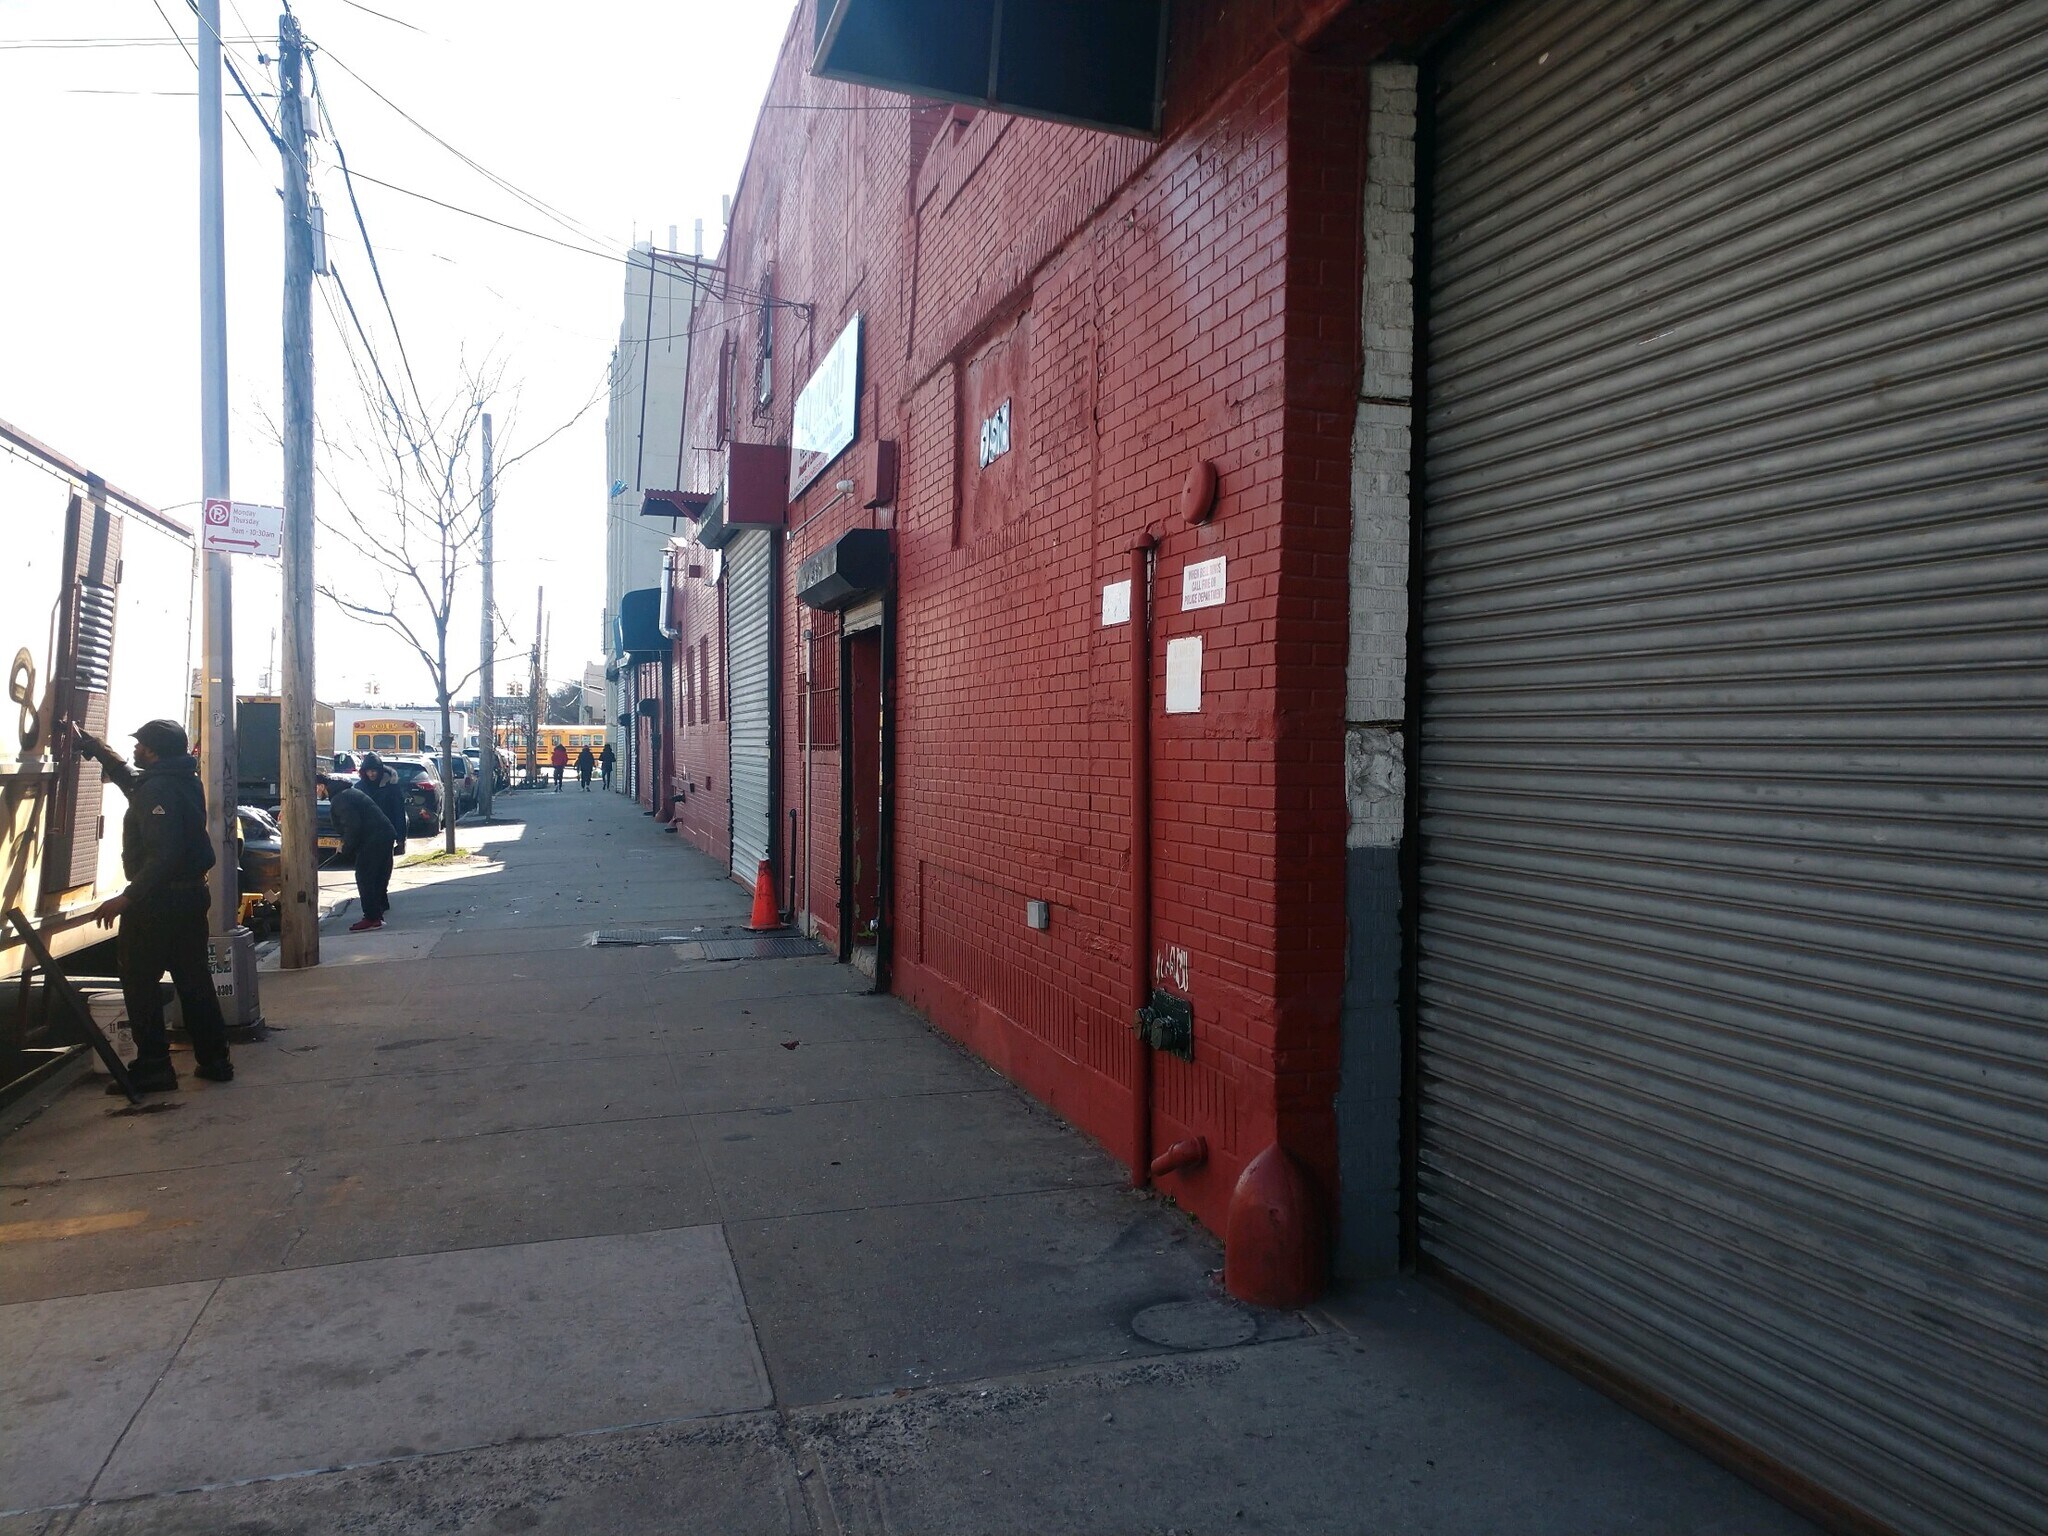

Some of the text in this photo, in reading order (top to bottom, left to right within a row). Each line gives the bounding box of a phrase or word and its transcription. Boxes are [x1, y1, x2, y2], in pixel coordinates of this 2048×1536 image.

[233, 509, 256, 517] Monday
[233, 517, 260, 527] Thursday
[1184, 587, 1223, 606] POLICE DEPARTMENT
